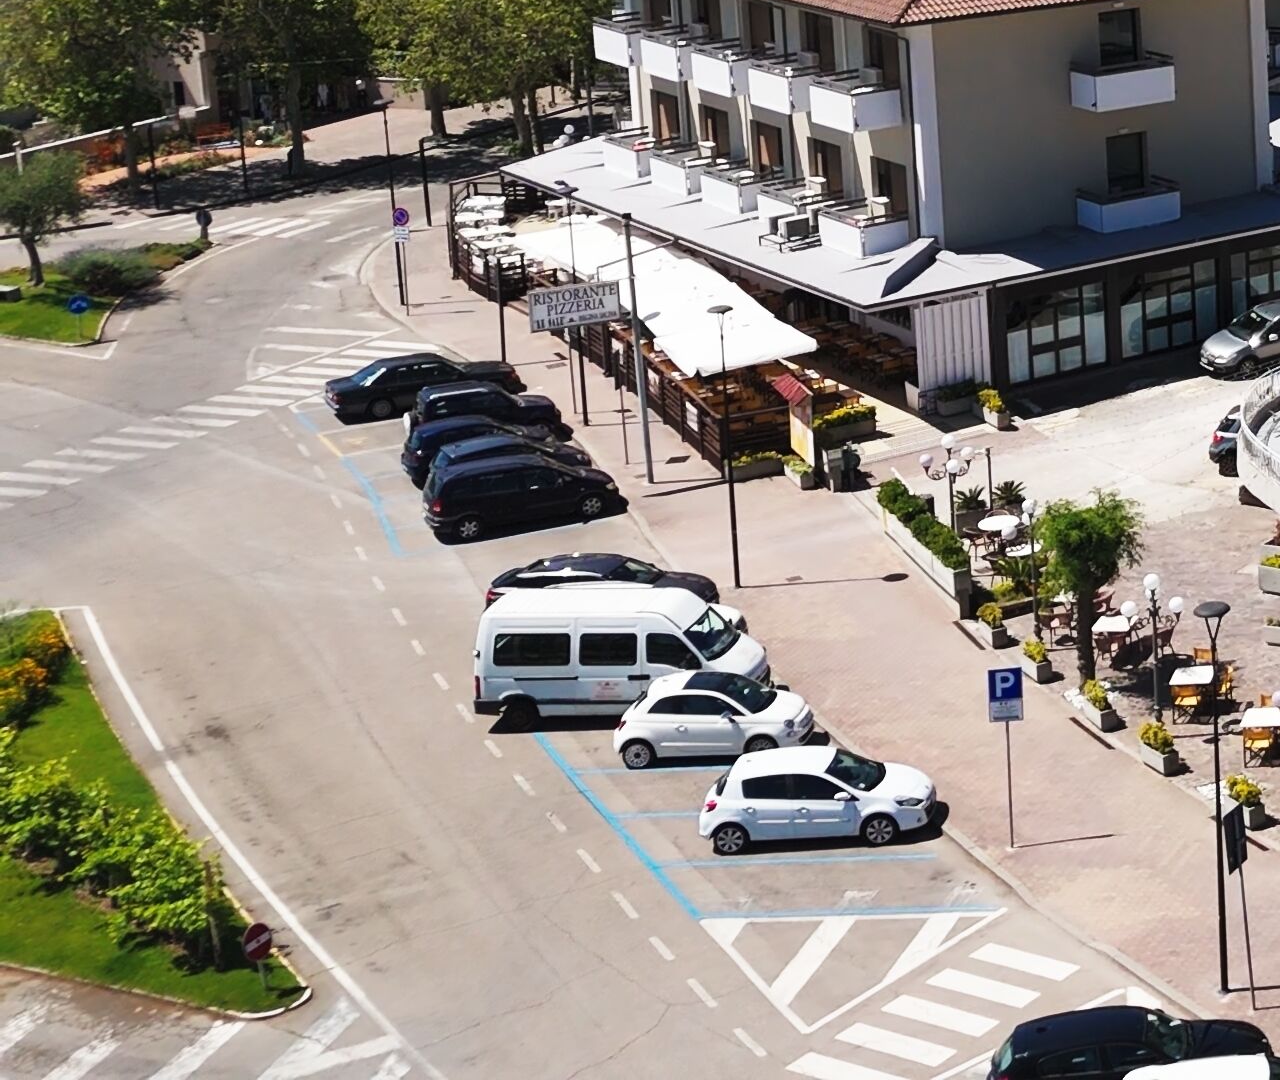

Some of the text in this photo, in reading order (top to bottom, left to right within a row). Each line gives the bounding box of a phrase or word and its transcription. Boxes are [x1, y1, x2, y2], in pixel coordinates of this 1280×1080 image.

[533, 283, 617, 306] RISTORANTE
[547, 297, 605, 317] PIZZERIA
[995, 671, 1015, 698] P
